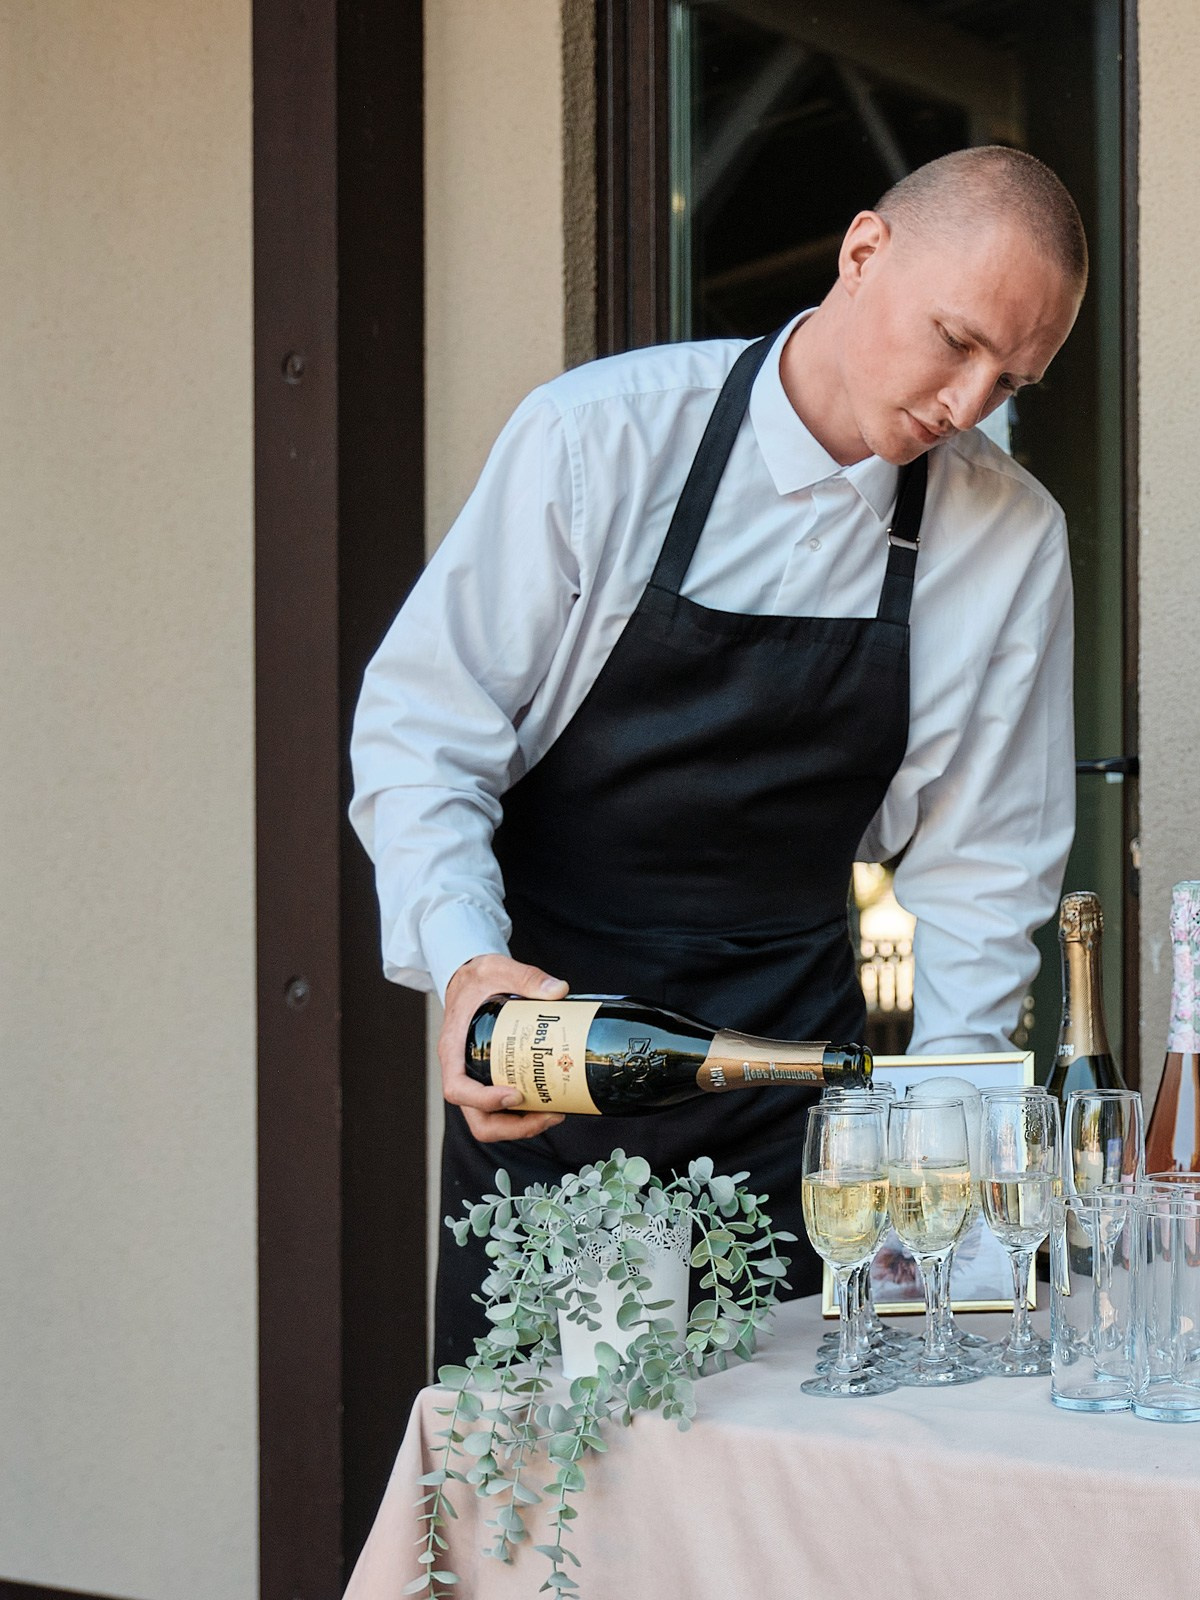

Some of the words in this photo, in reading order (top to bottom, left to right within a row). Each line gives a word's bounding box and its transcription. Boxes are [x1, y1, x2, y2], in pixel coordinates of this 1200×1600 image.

[534, 1014, 561, 1045] Левъ
[530, 1046, 554, 1104] Голицынъ
[742, 1061, 769, 1081] Левъ
[769, 1061, 818, 1081] Голицынъ
